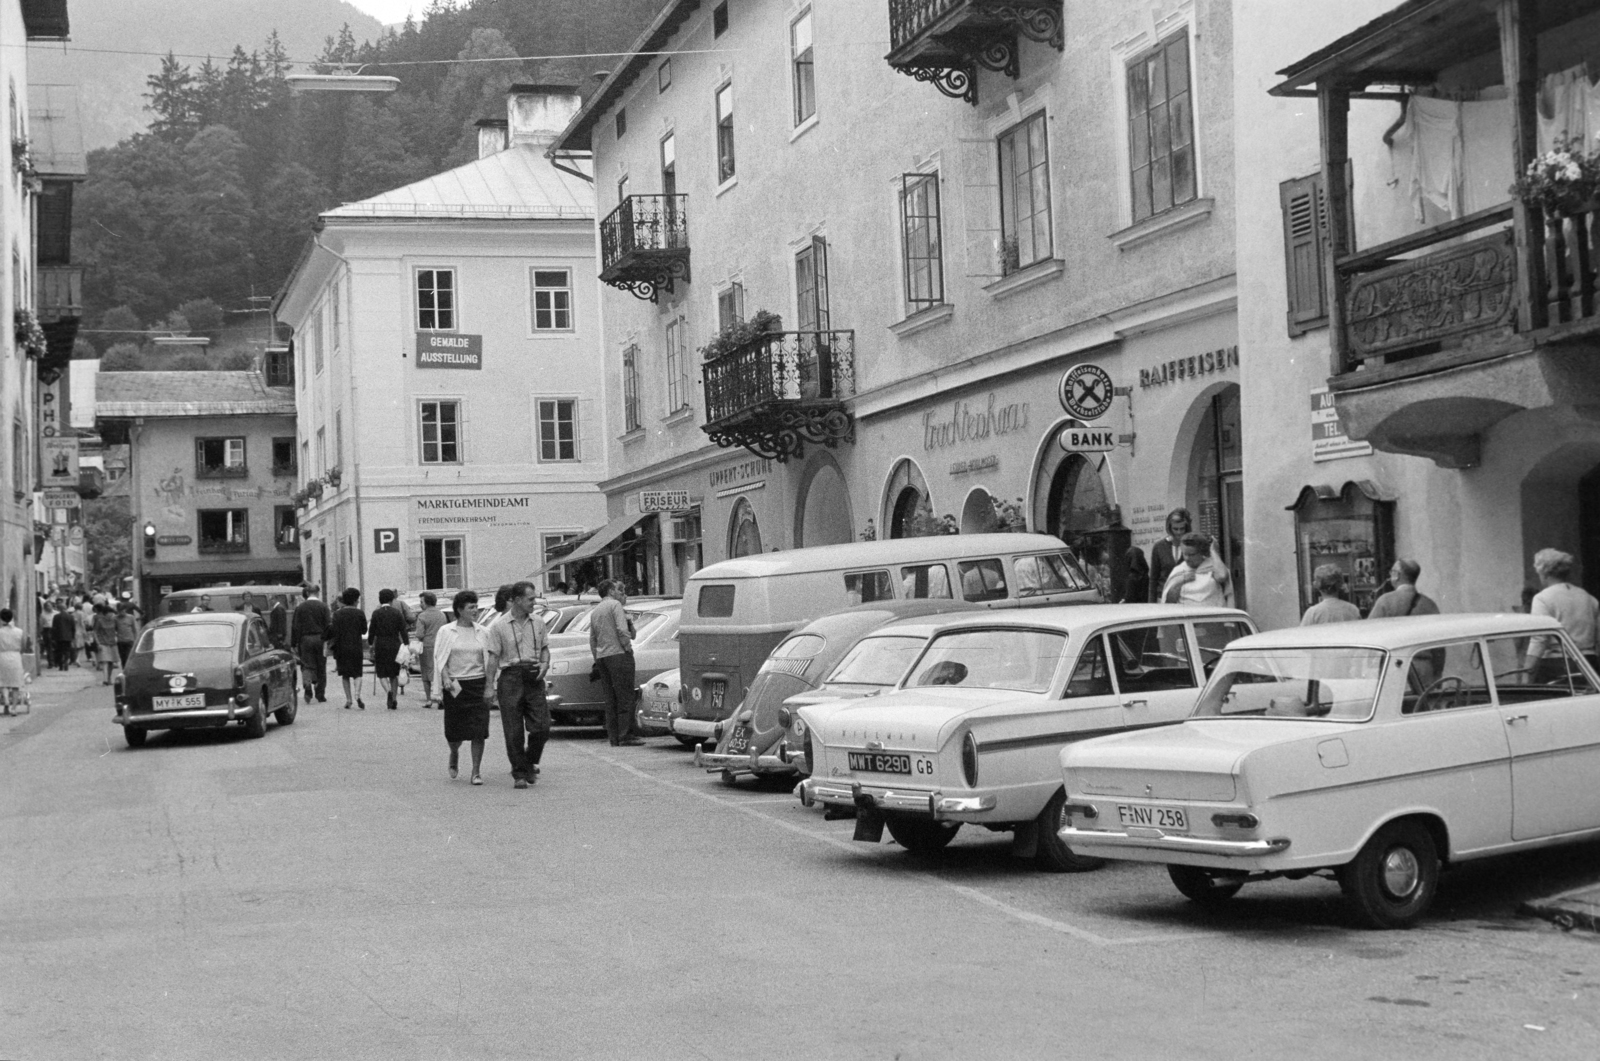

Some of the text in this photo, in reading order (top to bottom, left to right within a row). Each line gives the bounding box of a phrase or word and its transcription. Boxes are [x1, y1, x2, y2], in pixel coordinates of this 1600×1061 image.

[420, 352, 479, 364] AUSSTELLUNG
[1139, 344, 1240, 389] RAIFFEISEN
[1065, 367, 1111, 391] Raiffeisenkasse
[1068, 397, 1112, 417] Wechselstube
[1323, 422, 1342, 437] TEL.
[1071, 432, 1114, 446] BANK
[417, 498, 530, 509] MARKTGEMEINDEAMT
[643, 495, 688, 506] FRISEUR
[418, 516, 497, 524] FREMDENVERKEHRSAMT
[380, 531, 395, 551] P
[185, 697, 202, 706] 555
[735, 727, 746, 738] EX
[797, 721, 804, 732] A
[848, 753, 873, 770] MWT
[875, 756, 911, 773] 629D
[916, 759, 934, 775] GB
[1156, 809, 1185, 827] 258
